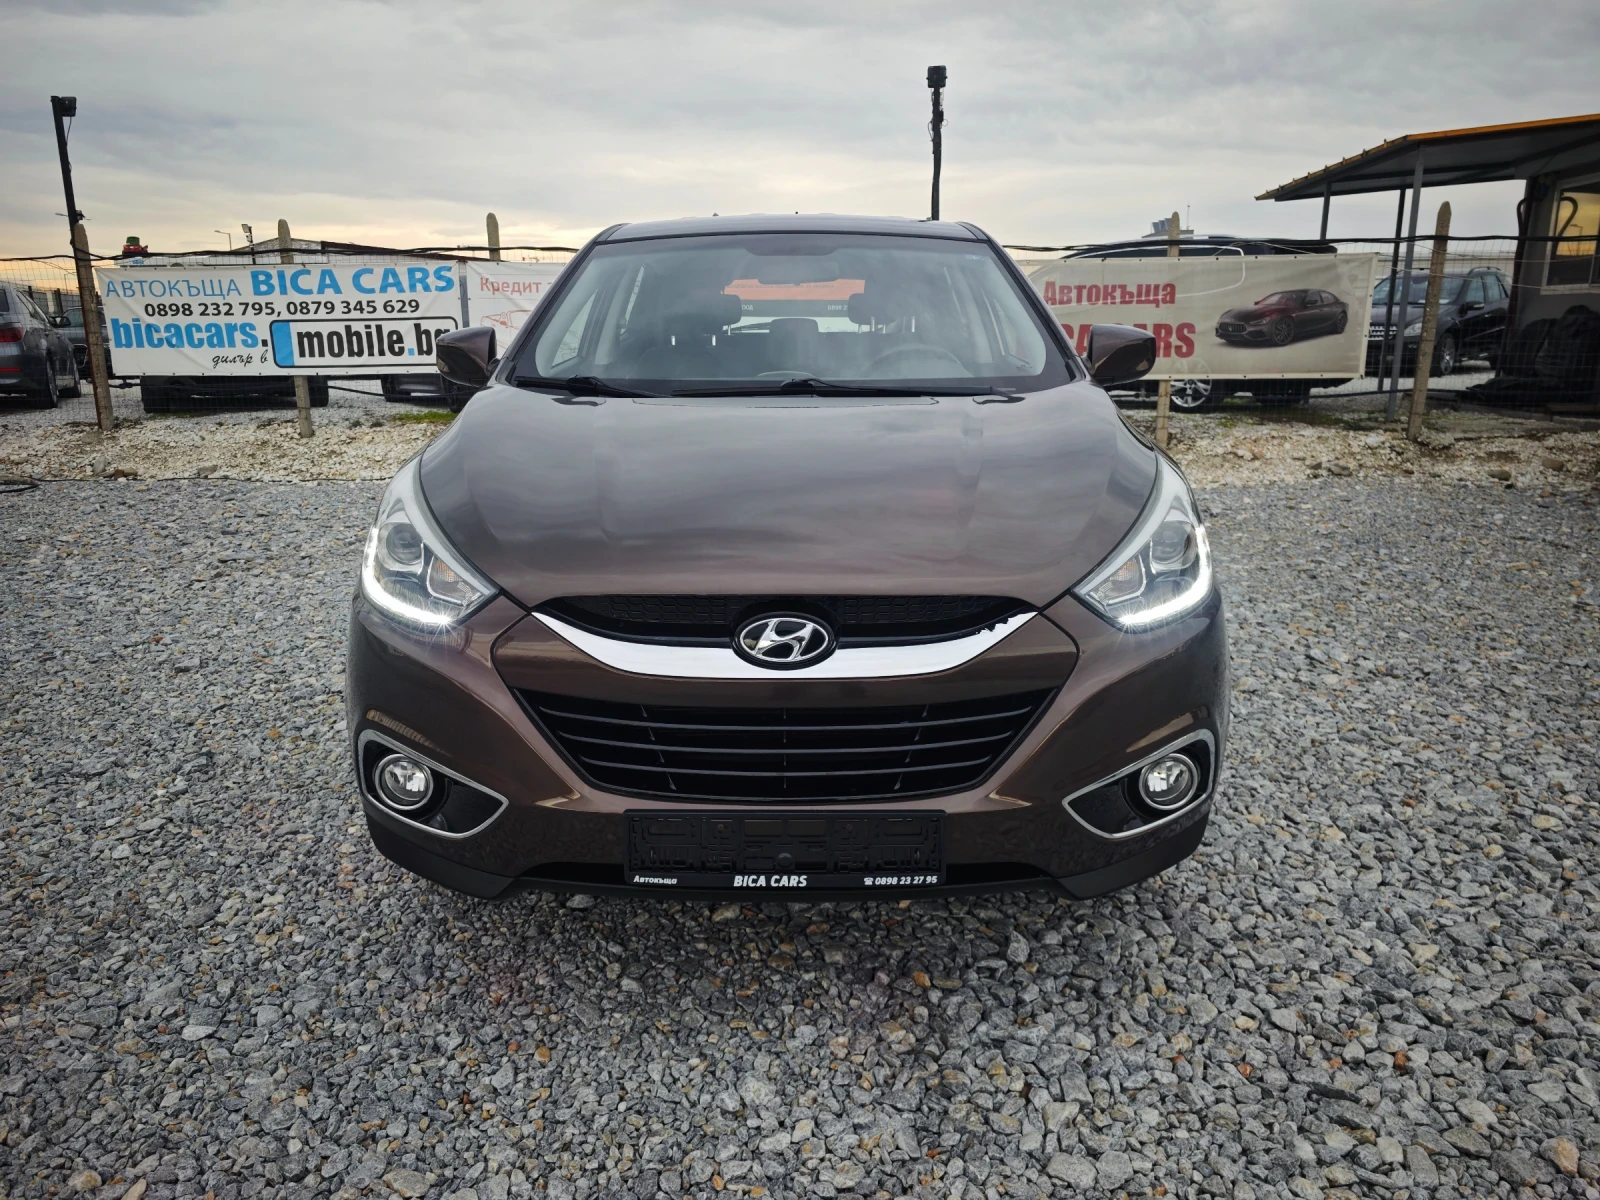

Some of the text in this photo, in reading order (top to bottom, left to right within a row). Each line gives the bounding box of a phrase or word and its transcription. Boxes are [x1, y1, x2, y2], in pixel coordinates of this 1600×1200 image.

[105, 265, 455, 300] АВТОКЪЩА BICA CARS
[480, 277, 542, 295] Кредит
[1043, 281, 1176, 308] Автокъща
[144, 299, 420, 318] 0898 232 795, 0879 345 629
[633, 875, 678, 885] Автокъща
[733, 875, 808, 887] BICA CARS
[874, 875, 938, 885] 0898 23 27 95
